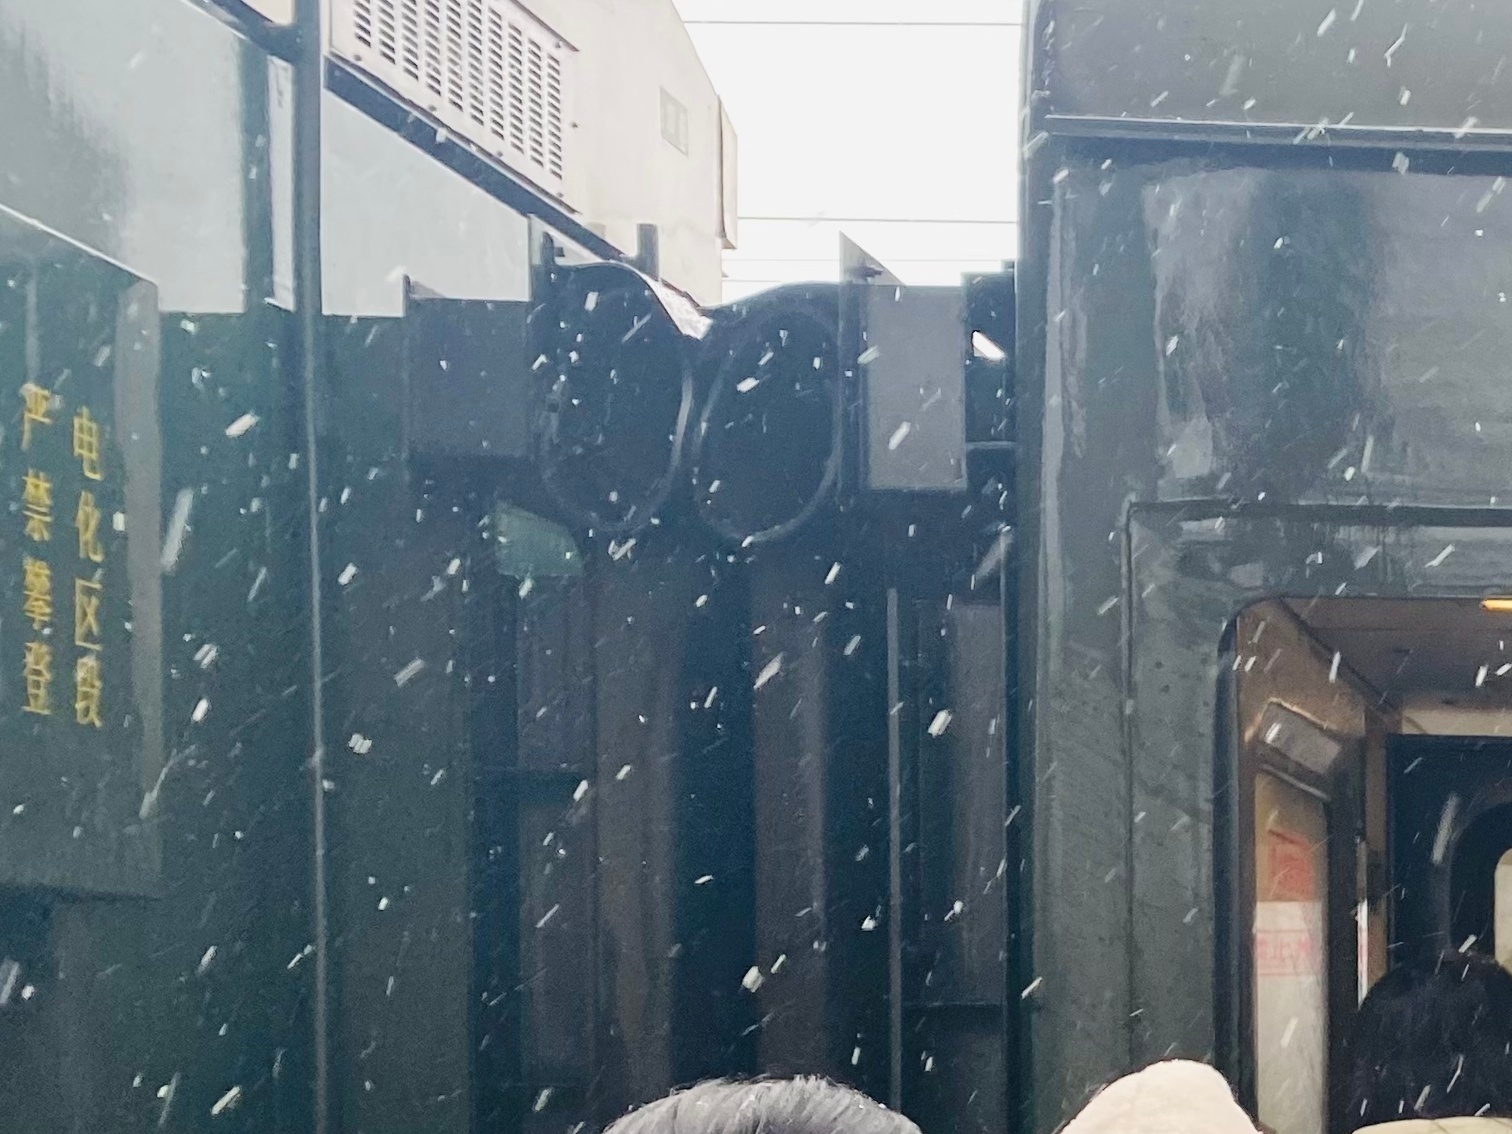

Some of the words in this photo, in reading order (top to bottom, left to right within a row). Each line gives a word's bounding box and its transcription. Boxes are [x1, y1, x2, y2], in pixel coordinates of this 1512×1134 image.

[20, 382, 51, 715] 严禁攀登
[73, 406, 103, 728] 电化区段
